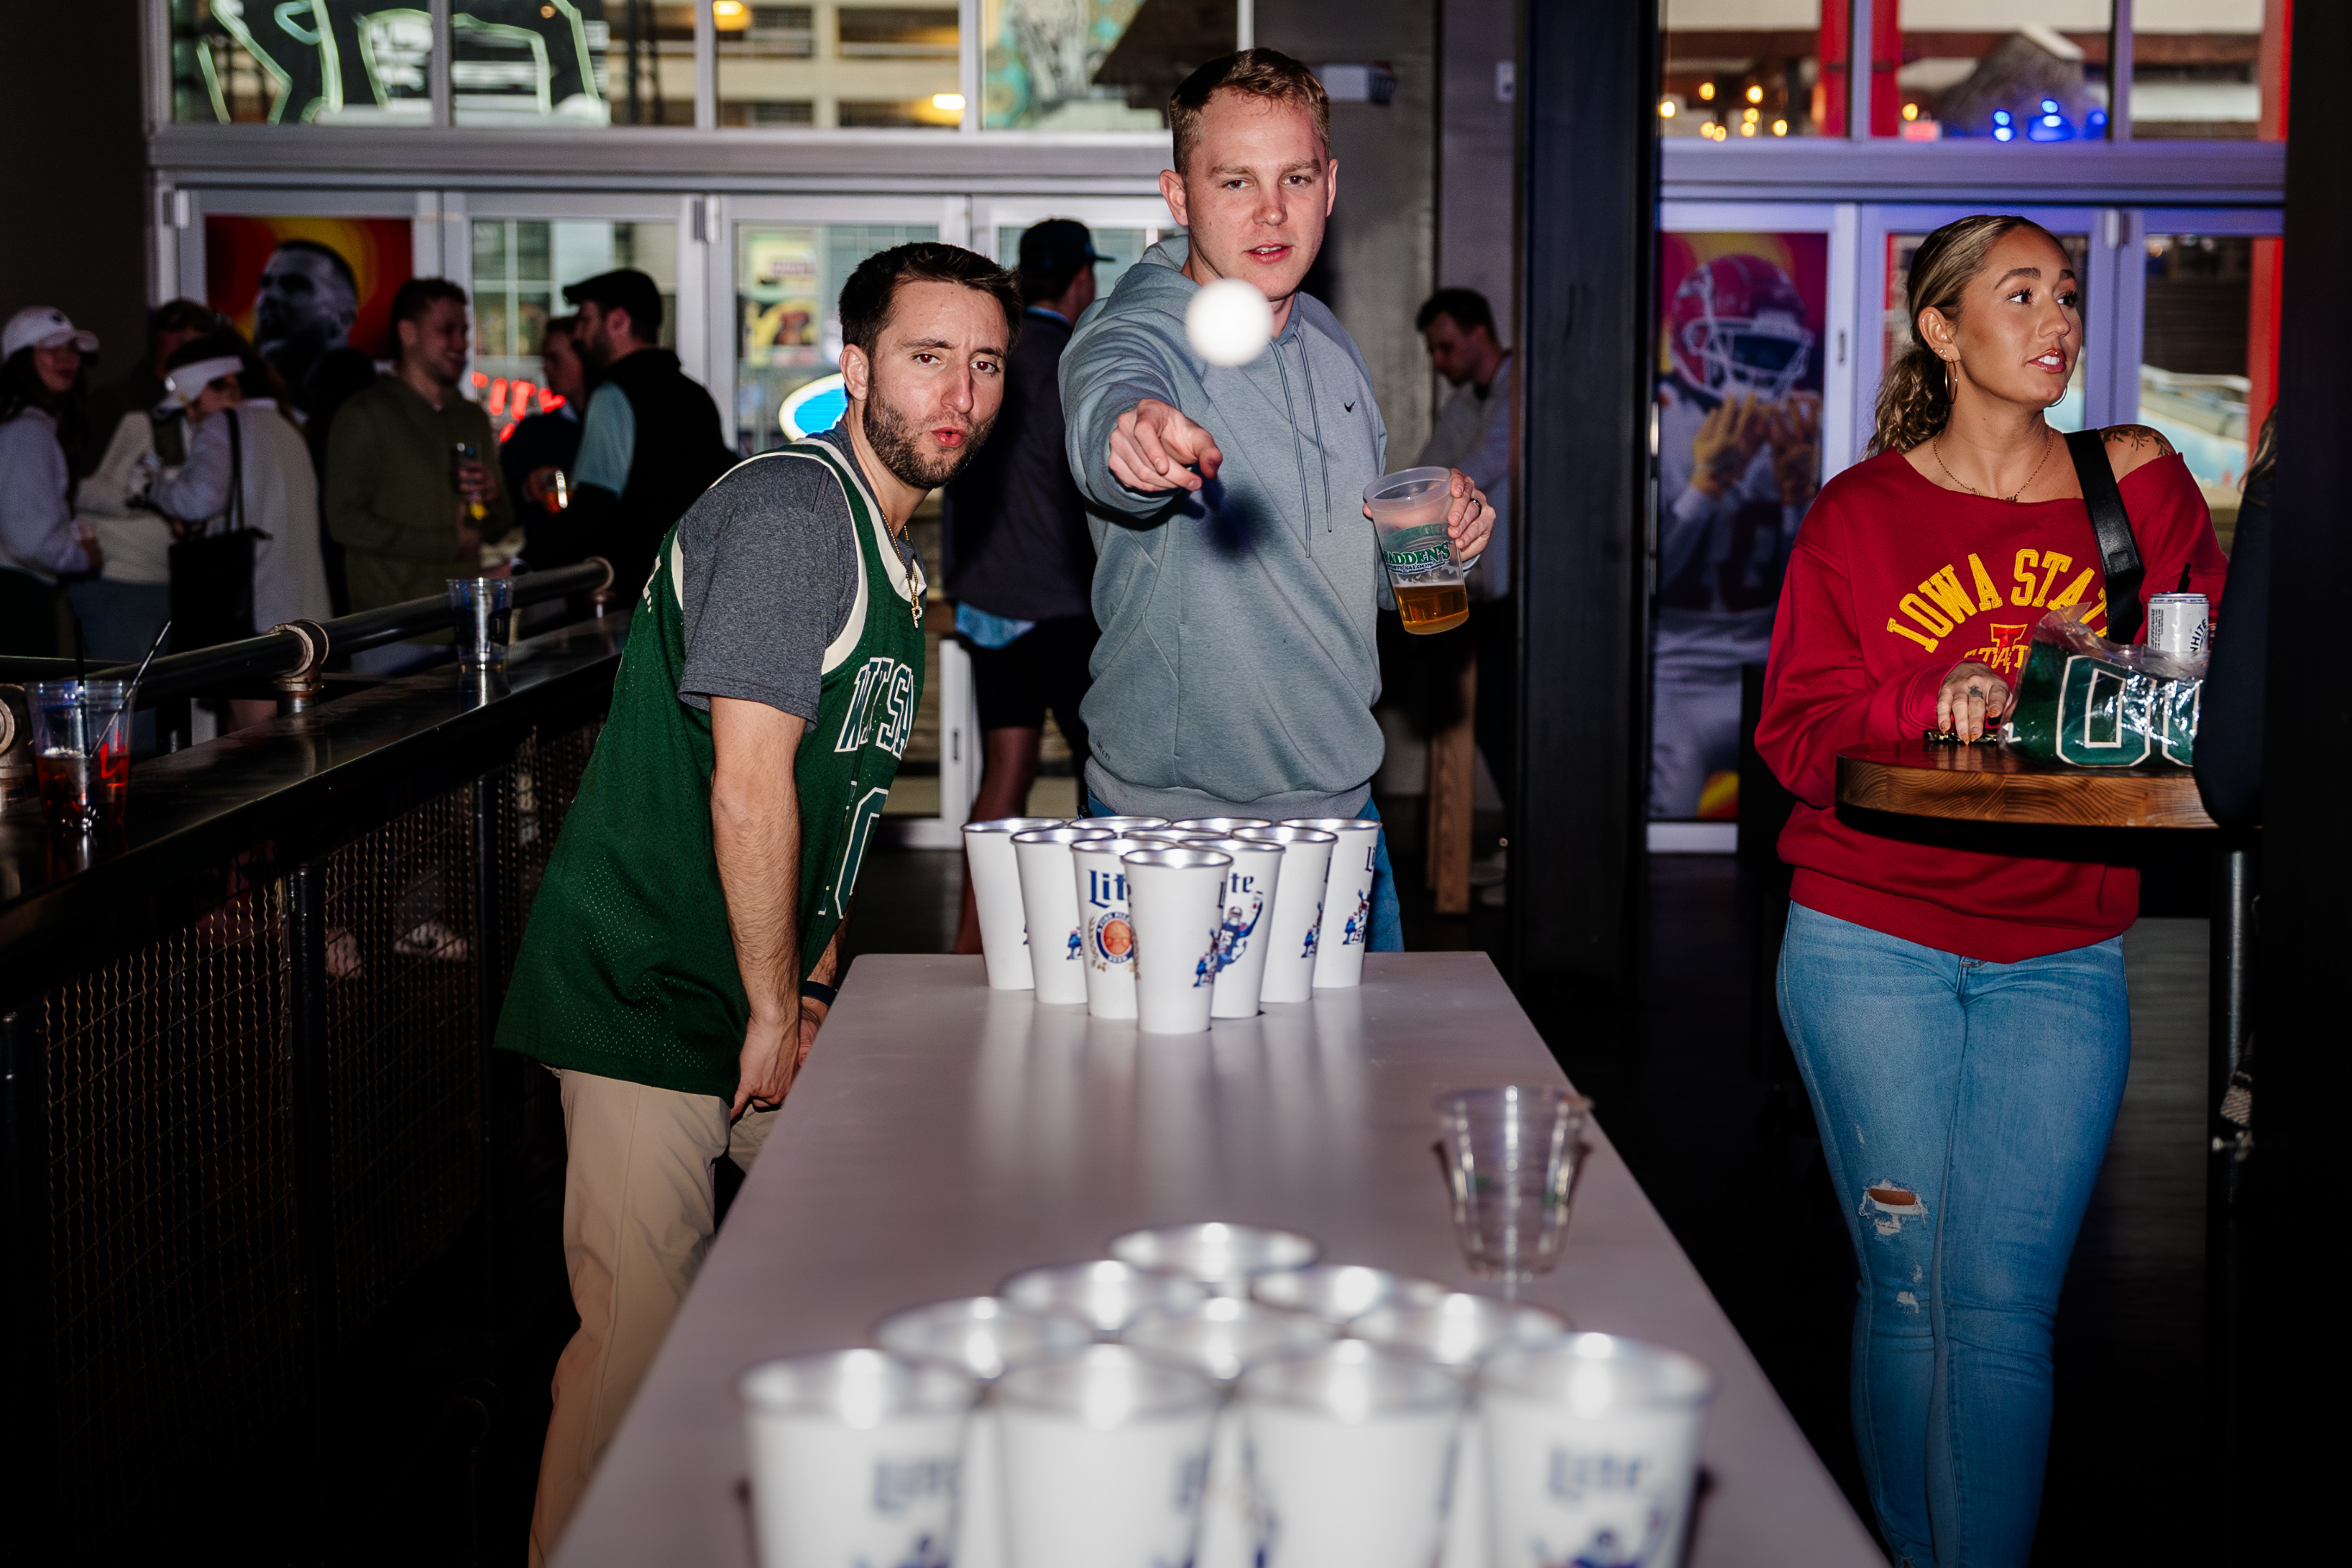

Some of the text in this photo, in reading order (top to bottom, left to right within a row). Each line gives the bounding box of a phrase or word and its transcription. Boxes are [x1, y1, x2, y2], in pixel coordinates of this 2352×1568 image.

[1886, 553, 2003, 653] IOWA
[2011, 549, 2107, 638] STAT
[1088, 869, 1127, 908] Lit
[1230, 872, 1254, 893] te
